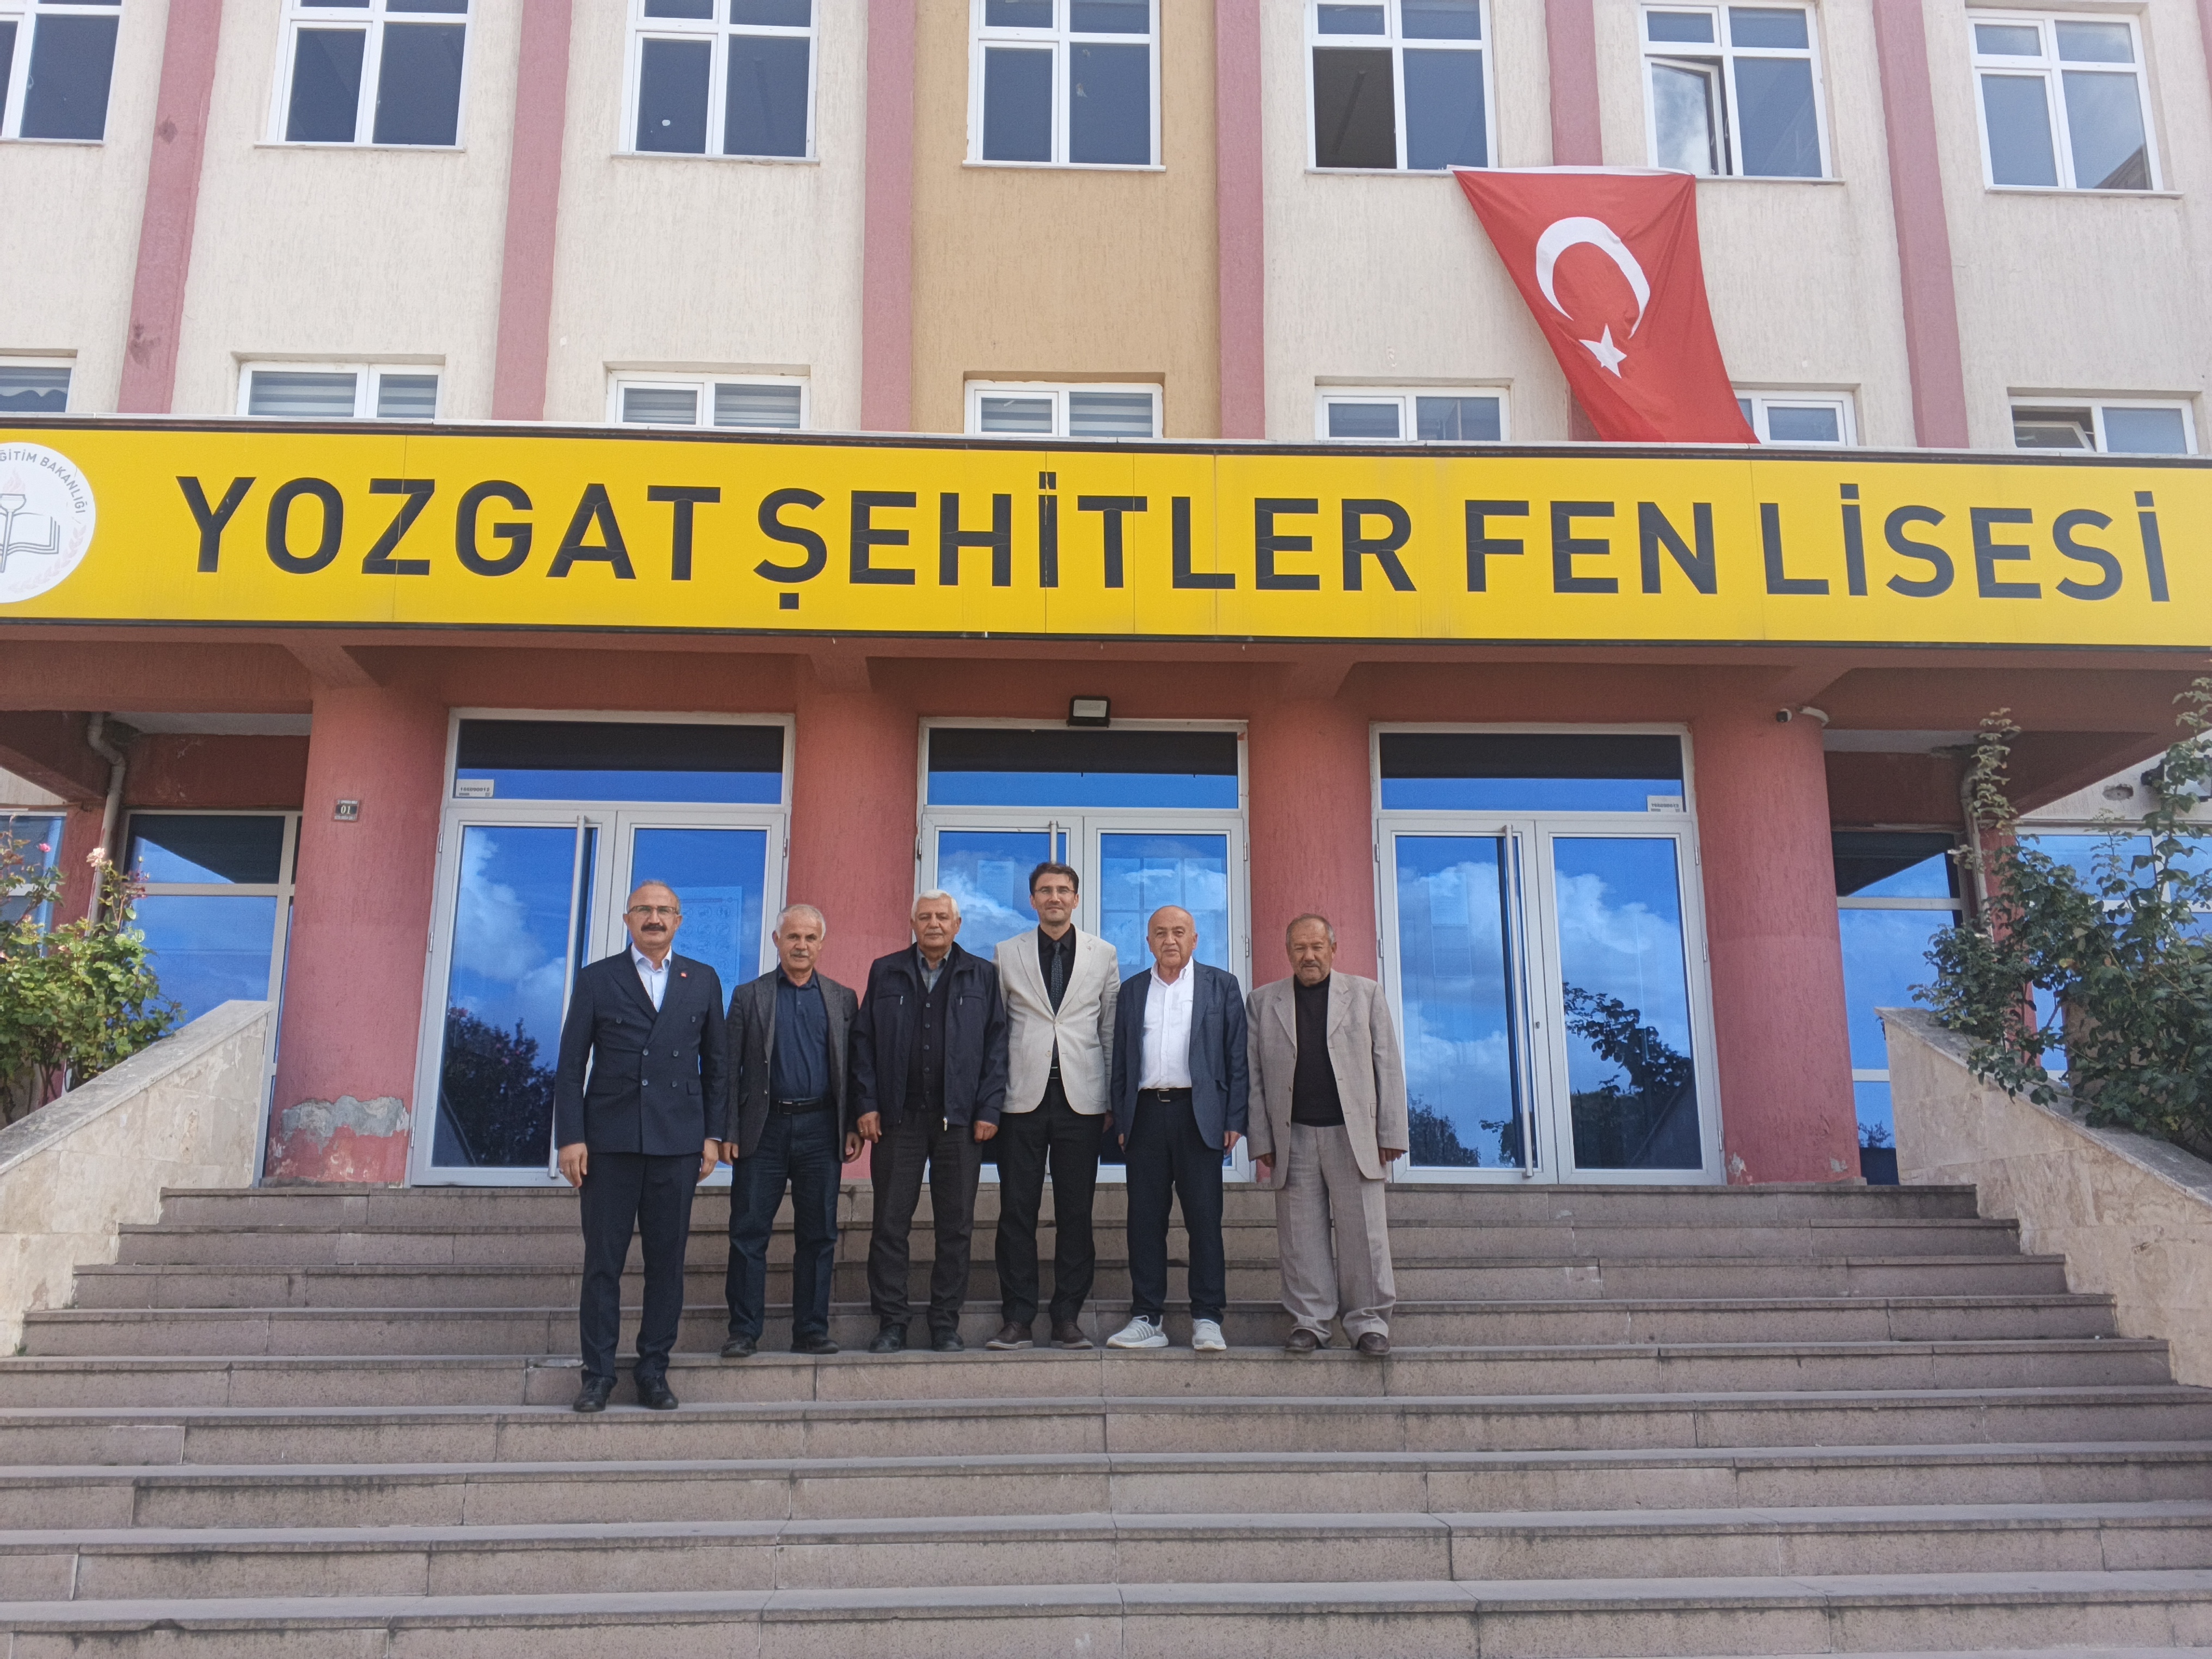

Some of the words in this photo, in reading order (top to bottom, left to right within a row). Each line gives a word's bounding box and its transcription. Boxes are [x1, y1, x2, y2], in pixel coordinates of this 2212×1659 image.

[40, 456, 87, 513] BAKANLIĞI
[176, 476, 721, 581] YOZGAT
[753, 471, 1417, 610] ŞEHİTLER
[1464, 499, 1718, 594] FEN
[1759, 483, 2170, 602] LİSESİ
[340, 805, 351, 814] 01
